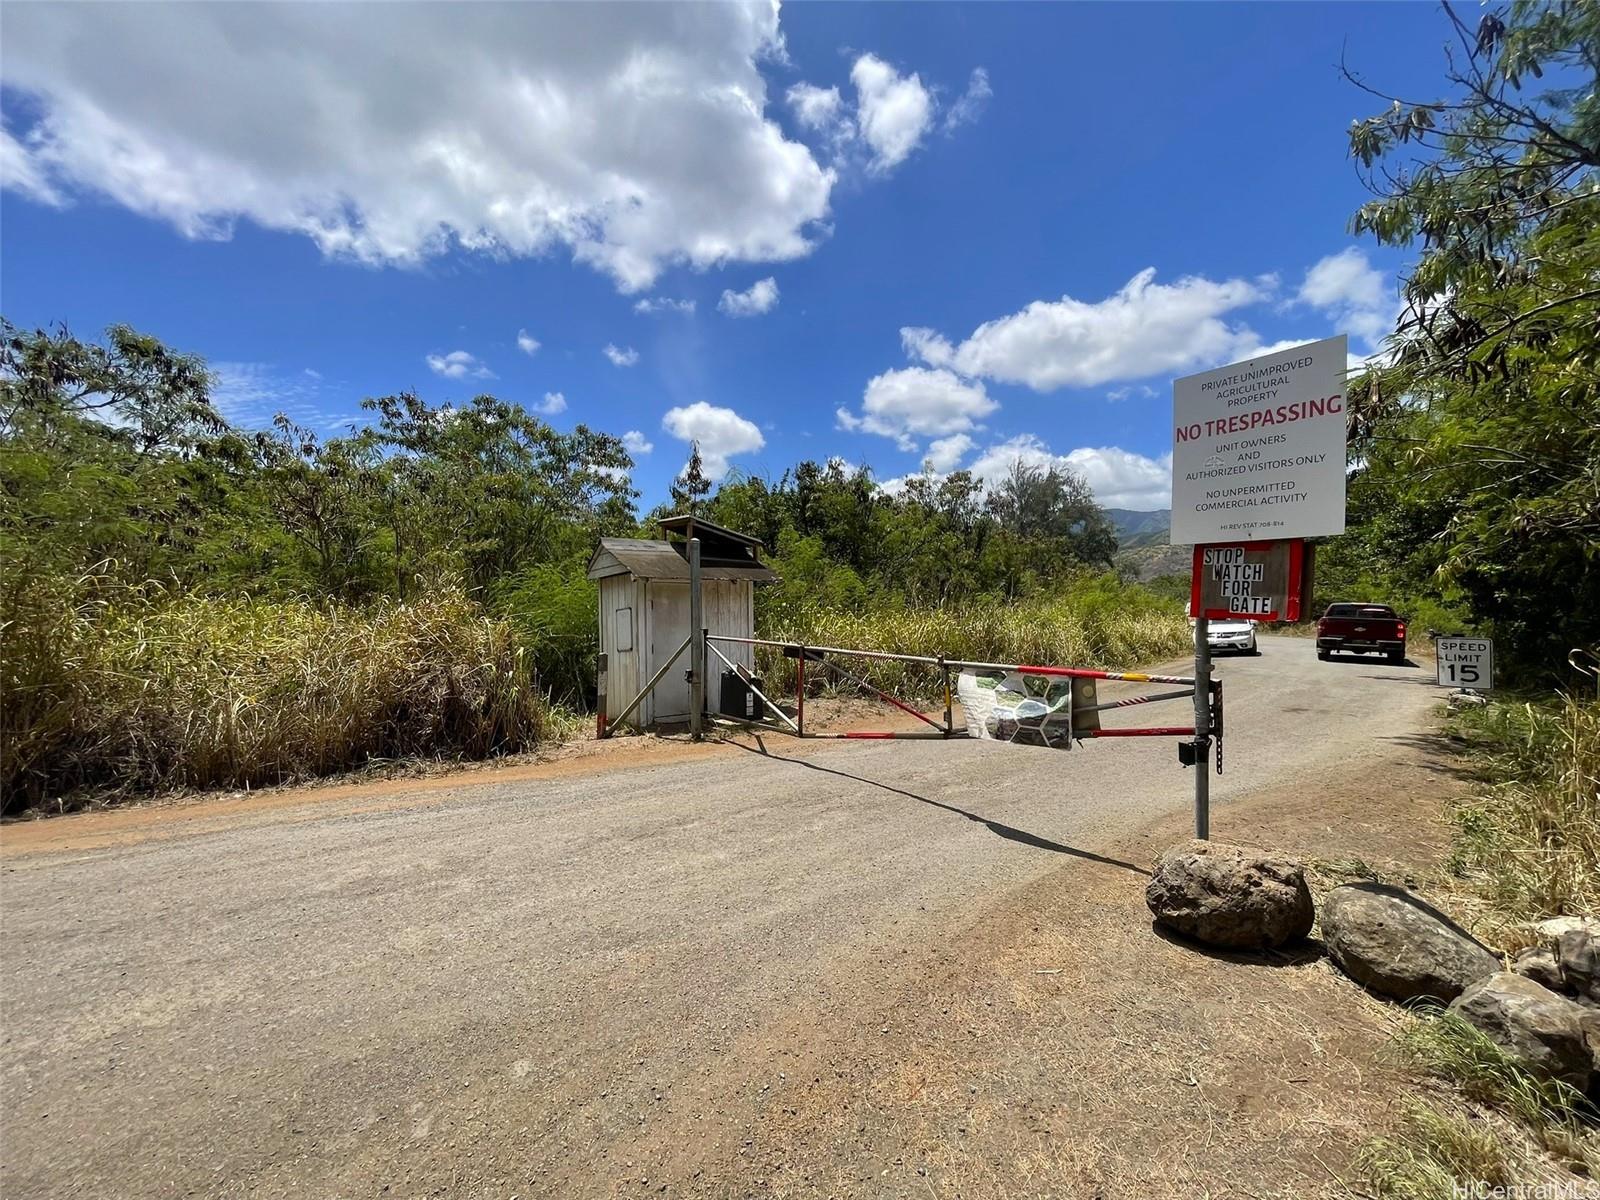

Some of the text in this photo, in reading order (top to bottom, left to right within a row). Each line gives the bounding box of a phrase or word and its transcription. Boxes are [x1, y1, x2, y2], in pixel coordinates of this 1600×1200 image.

[1201, 356, 1313, 392] PRIVATE UNIMPROVED
[1216, 376, 1290, 400] AGRICULTURAL
[1227, 390, 1278, 408] PROPERTY
[1176, 394, 1342, 443] NO TRESPASSING
[1216, 433, 1287, 453] UNIT OWNERS
[1237, 450, 1261, 462] AND
[1185, 453, 1327, 481] AUTHORIZED VISITORS ONLY
[1206, 480, 1296, 499] NO UNPERMITTED
[1195, 492, 1308, 512] COMMERCIAL ACTIVITY
[1242, 521, 1258, 529] STAT
[1204, 548, 1243, 564] STOP
[1214, 564, 1262, 580] WATCH
[1222, 580, 1251, 597] FOR
[1231, 596, 1270, 614] GATE
[1441, 642, 1487, 652] SPEED
[1445, 653, 1482, 663] LIMIT
[1447, 664, 1480, 683] 15
